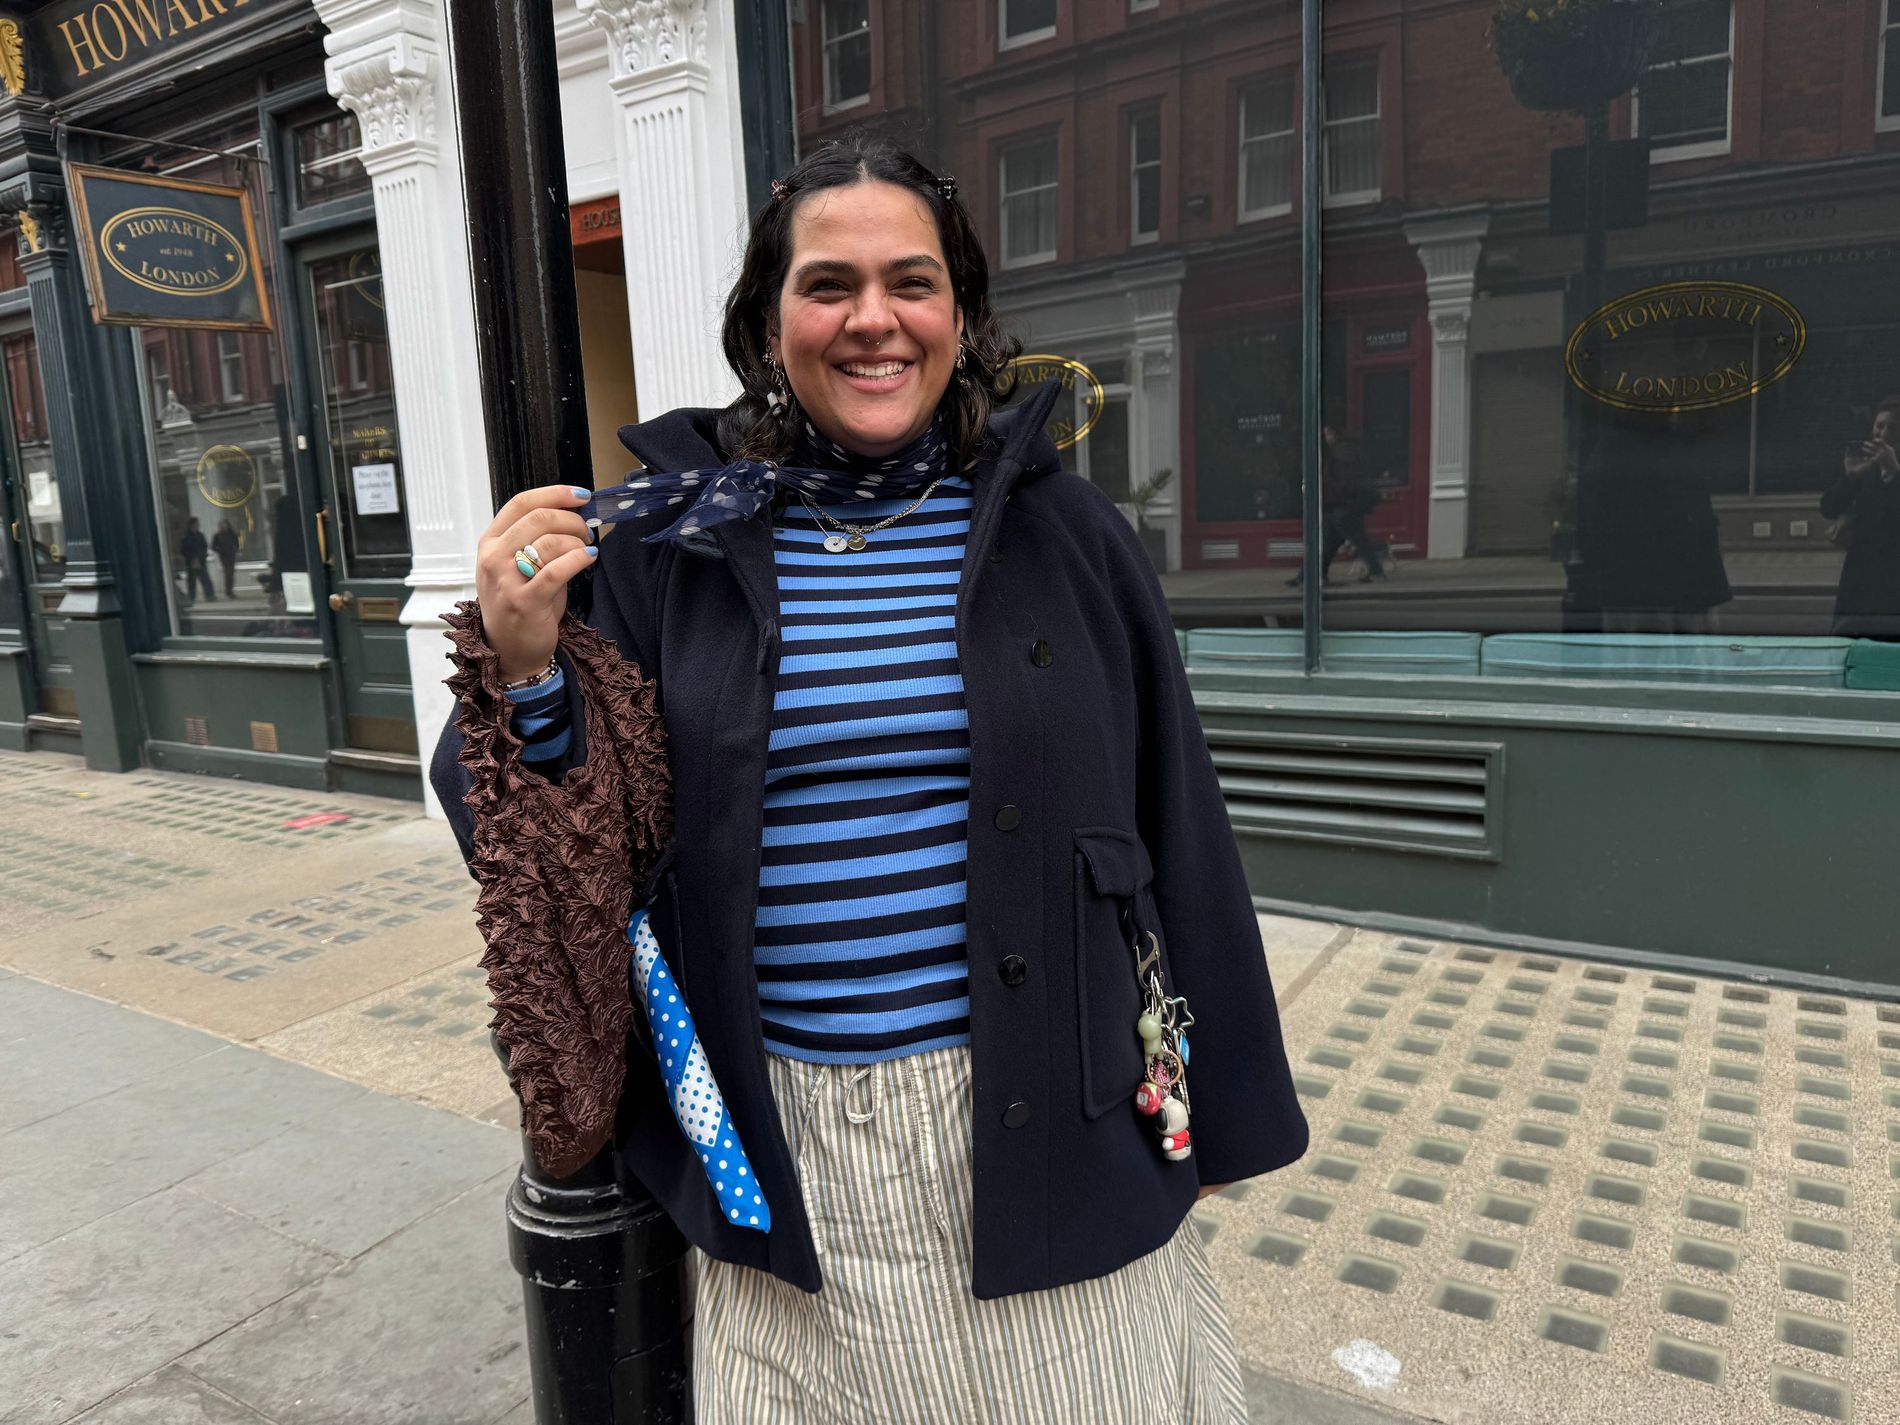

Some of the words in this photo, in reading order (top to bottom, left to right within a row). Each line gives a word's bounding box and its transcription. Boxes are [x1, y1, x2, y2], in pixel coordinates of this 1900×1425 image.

[56, 0, 249, 77] HOWA
[126, 218, 218, 246] HOWARTH
[582, 207, 619, 230] HOUS
[141, 260, 221, 286] LONDON
[1604, 295, 1763, 340] HOWARTH
[994, 365, 1076, 392] OWARTH
[1614, 360, 1750, 398] LONDON
